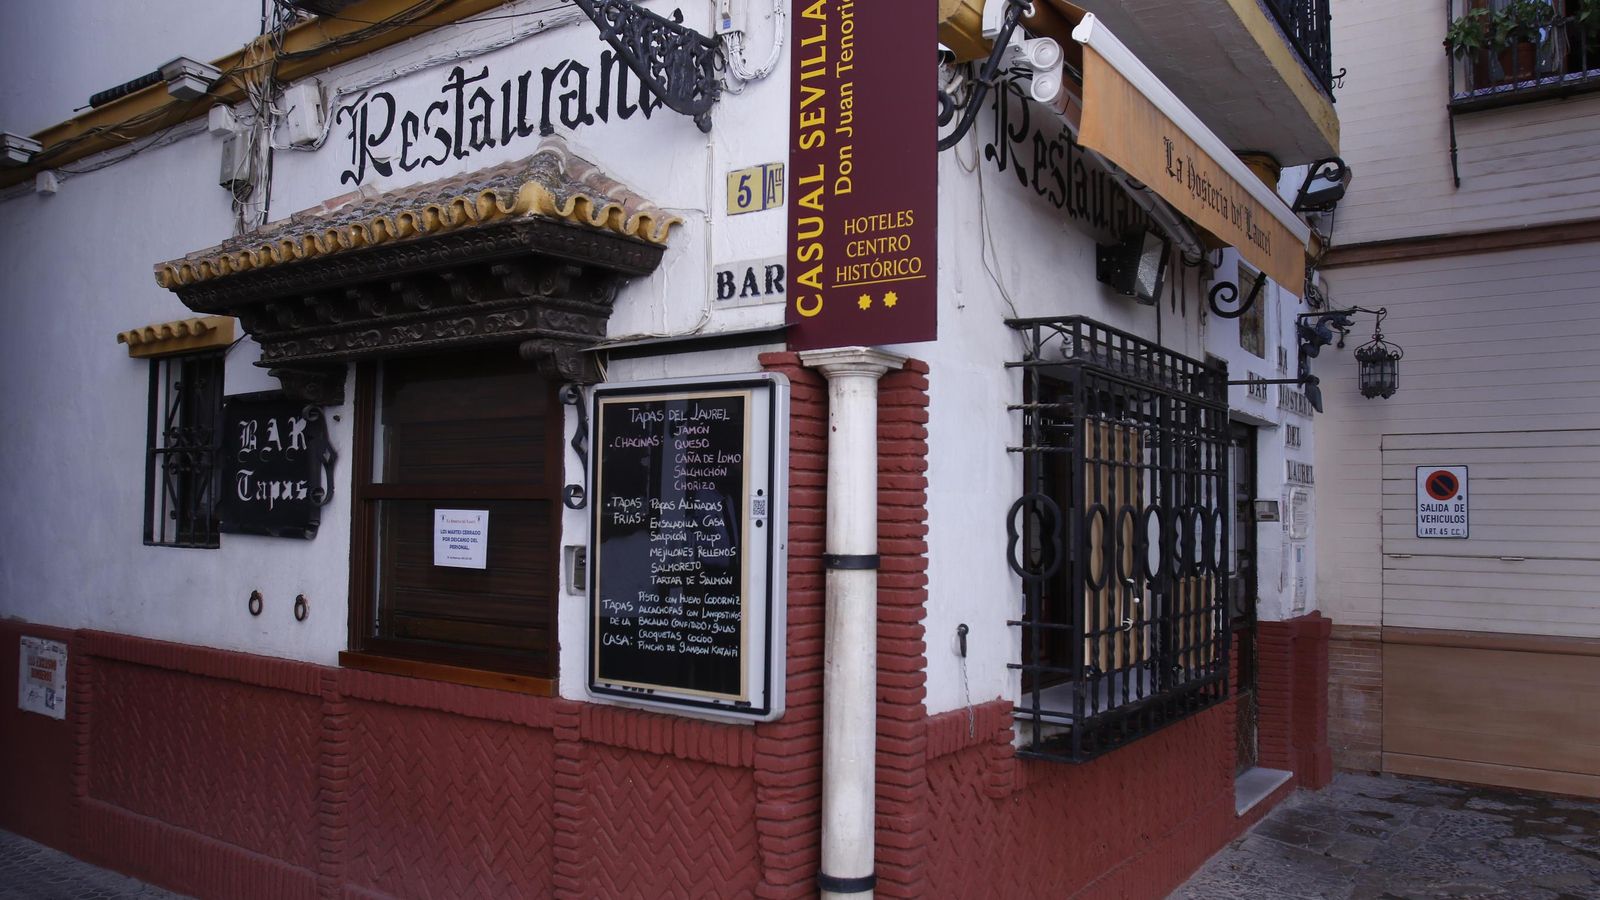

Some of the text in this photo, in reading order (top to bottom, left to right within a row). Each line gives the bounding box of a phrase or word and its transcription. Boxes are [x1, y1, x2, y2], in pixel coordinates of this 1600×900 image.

[835, 0, 854, 196] Don Juan Tenori
[796, 0, 828, 318] CASUAL SEVILLA
[1163, 136, 1183, 185] La
[737, 174, 752, 208] 5
[844, 209, 914, 236] HOTELES
[846, 234, 911, 258] CENTRO
[836, 256, 922, 283] HISTÓRICO
[716, 263, 785, 301] BAR
[669, 409, 688, 421] DEL
[690, 402, 730, 421] LAUREL
[238, 416, 307, 456] BAR
[674, 438, 710, 450] QUESO
[1286, 423, 1301, 447] DEL
[675, 449, 742, 464] CAÑA DE LOMO
[236, 469, 308, 512] Tapas
[1420, 503, 1466, 513] SALIDA DE
[1420, 514, 1466, 524] VEHICULOS
[702, 514, 725, 527] CASA
[1439, 527, 1448, 536] 45
[649, 575, 683, 585] TARTAR
[686, 575, 695, 585] DE
[609, 617, 620, 626] DE
